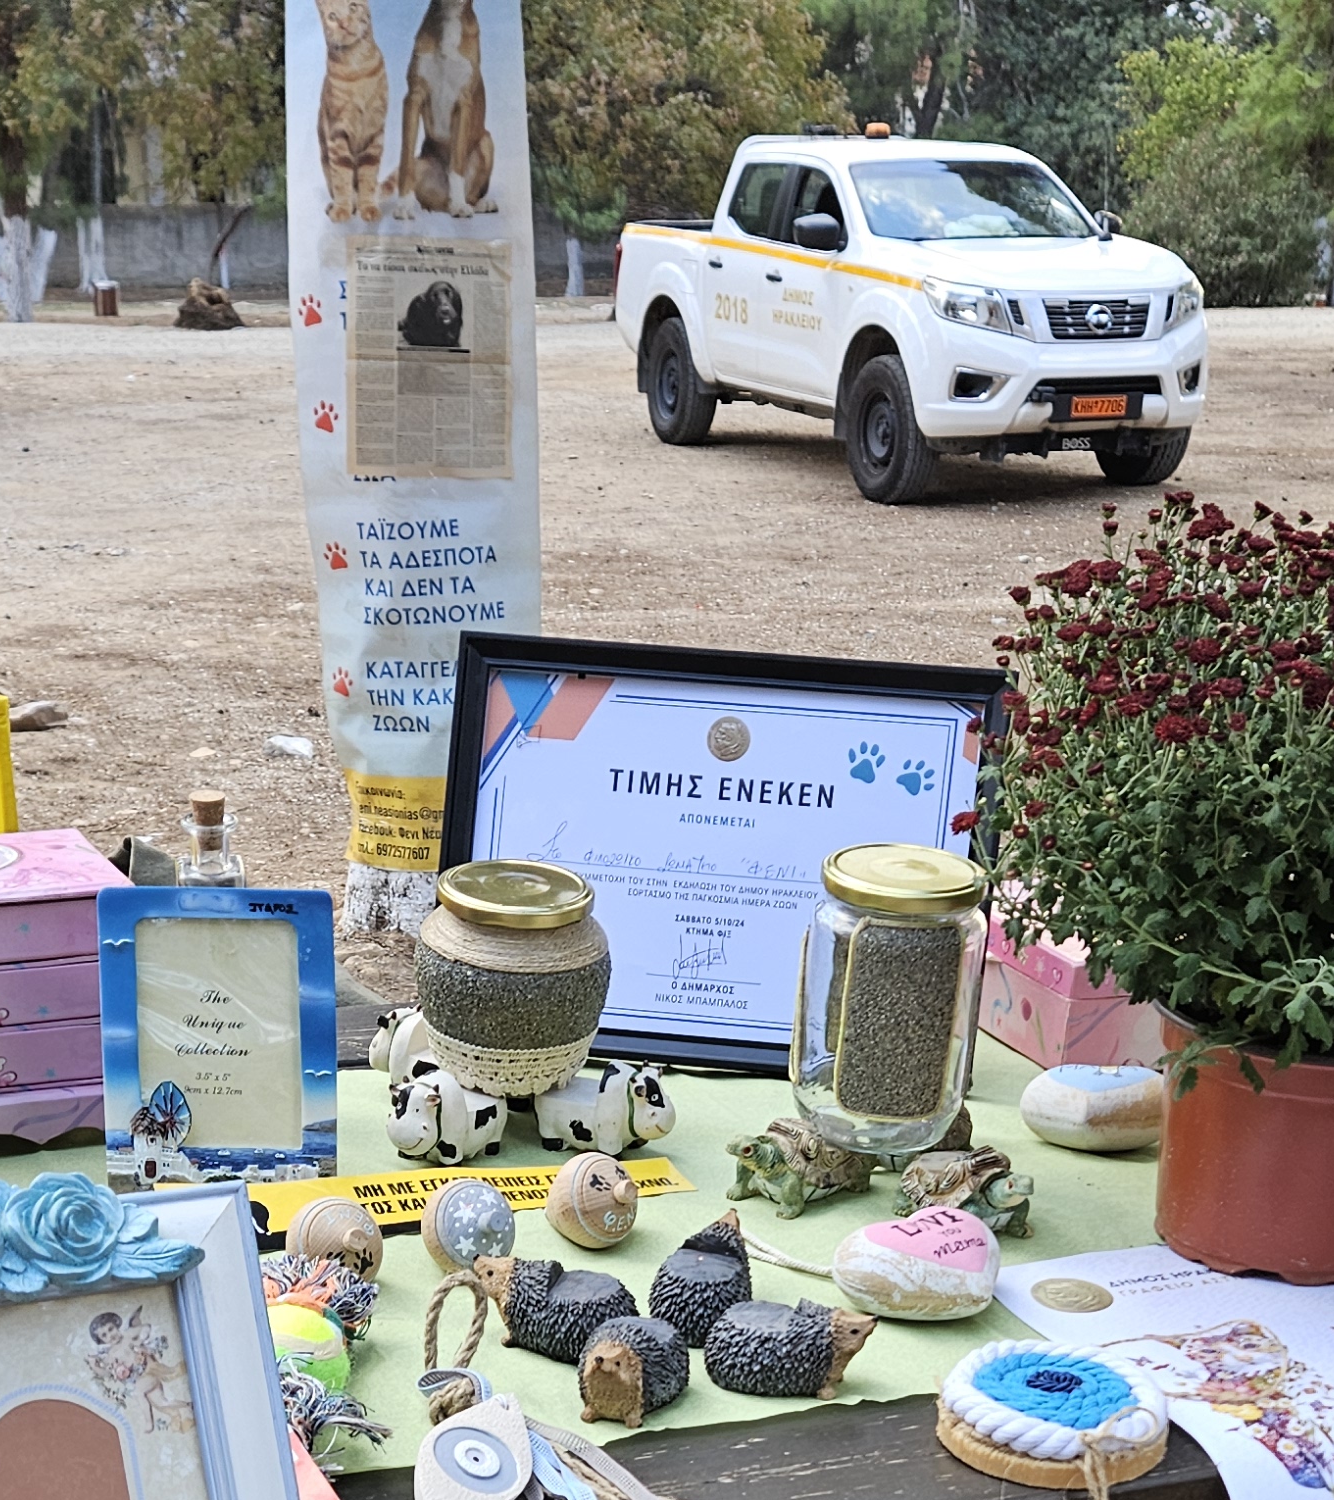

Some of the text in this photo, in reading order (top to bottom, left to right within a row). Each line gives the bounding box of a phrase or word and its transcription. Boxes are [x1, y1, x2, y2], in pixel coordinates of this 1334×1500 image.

[715, 292, 748, 324] 2018
[772, 309, 822, 331] ΗΡΑΚΛΕΙΟΥ
[356, 518, 459, 540] ΤΑΪΖΟΥΜΕ
[359, 545, 497, 569] ΤΑ ΑΔΕΣΠΟΤΑ
[364, 575, 475, 597] ΚΑΙ ΔΕΝ ΤΑ
[363, 601, 505, 626] ΣΚΟΤΩΝΟΥΜΕ
[366, 688, 404, 706] ΤΗΝ
[373, 715, 430, 733] ΖΩΩΝ
[609, 768, 835, 809] ΤΙΜΗΣ ΕΝΕΚΕΝ
[679, 813, 756, 829] ΑΠΟΝΕΜΕΤΑΙ
[629, 876, 644, 885] ΤΟΥ
[647, 878, 667, 887] ΣΤΗΝ
[673, 880, 717, 891] ΕΚΔΗΛΩΣΗ
[720, 884, 737, 892] ΤΟΥ
[738, 886, 769, 895] ΔΗΜΟΥ
[772, 888, 819, 899] ΗΡΑΚΛΕΙΟΥ
[628, 888, 798, 910] ΕΟΡΤΑΣΜΟ ΤΗΣ ΠΑΓΚΟΣΜΙΑ ΗΜΕΡΑ ΖΩΩΝ
[675, 914, 745, 927] ΣΑΒΒΑΤΟ 5/10/24
[685, 927, 714, 937] ΚΤΗΜΑ
[199, 990, 233, 1004] The
[671, 981, 735, 995] Ο ΔΗΜΑΡΧΟΣ
[654, 993, 749, 1010] ΝΙΚΟΣ ΜΠΑΜΠΑΛΟΣ
[182, 1014, 247, 1034] Unique
[174, 1042, 252, 1057] Collection
[184, 1086, 202, 1094] 9cm
[211, 1086, 243, 1096] 12.7cm
[353, 1183, 386, 1198] ΜΗ
[387, 1181, 418, 1196] ΜΕ
[1109, 1273, 1169, 1288] ΔΗΜΟΣ
[1118, 1281, 1193, 1297] ΓΡΑΦΕΙΟ
